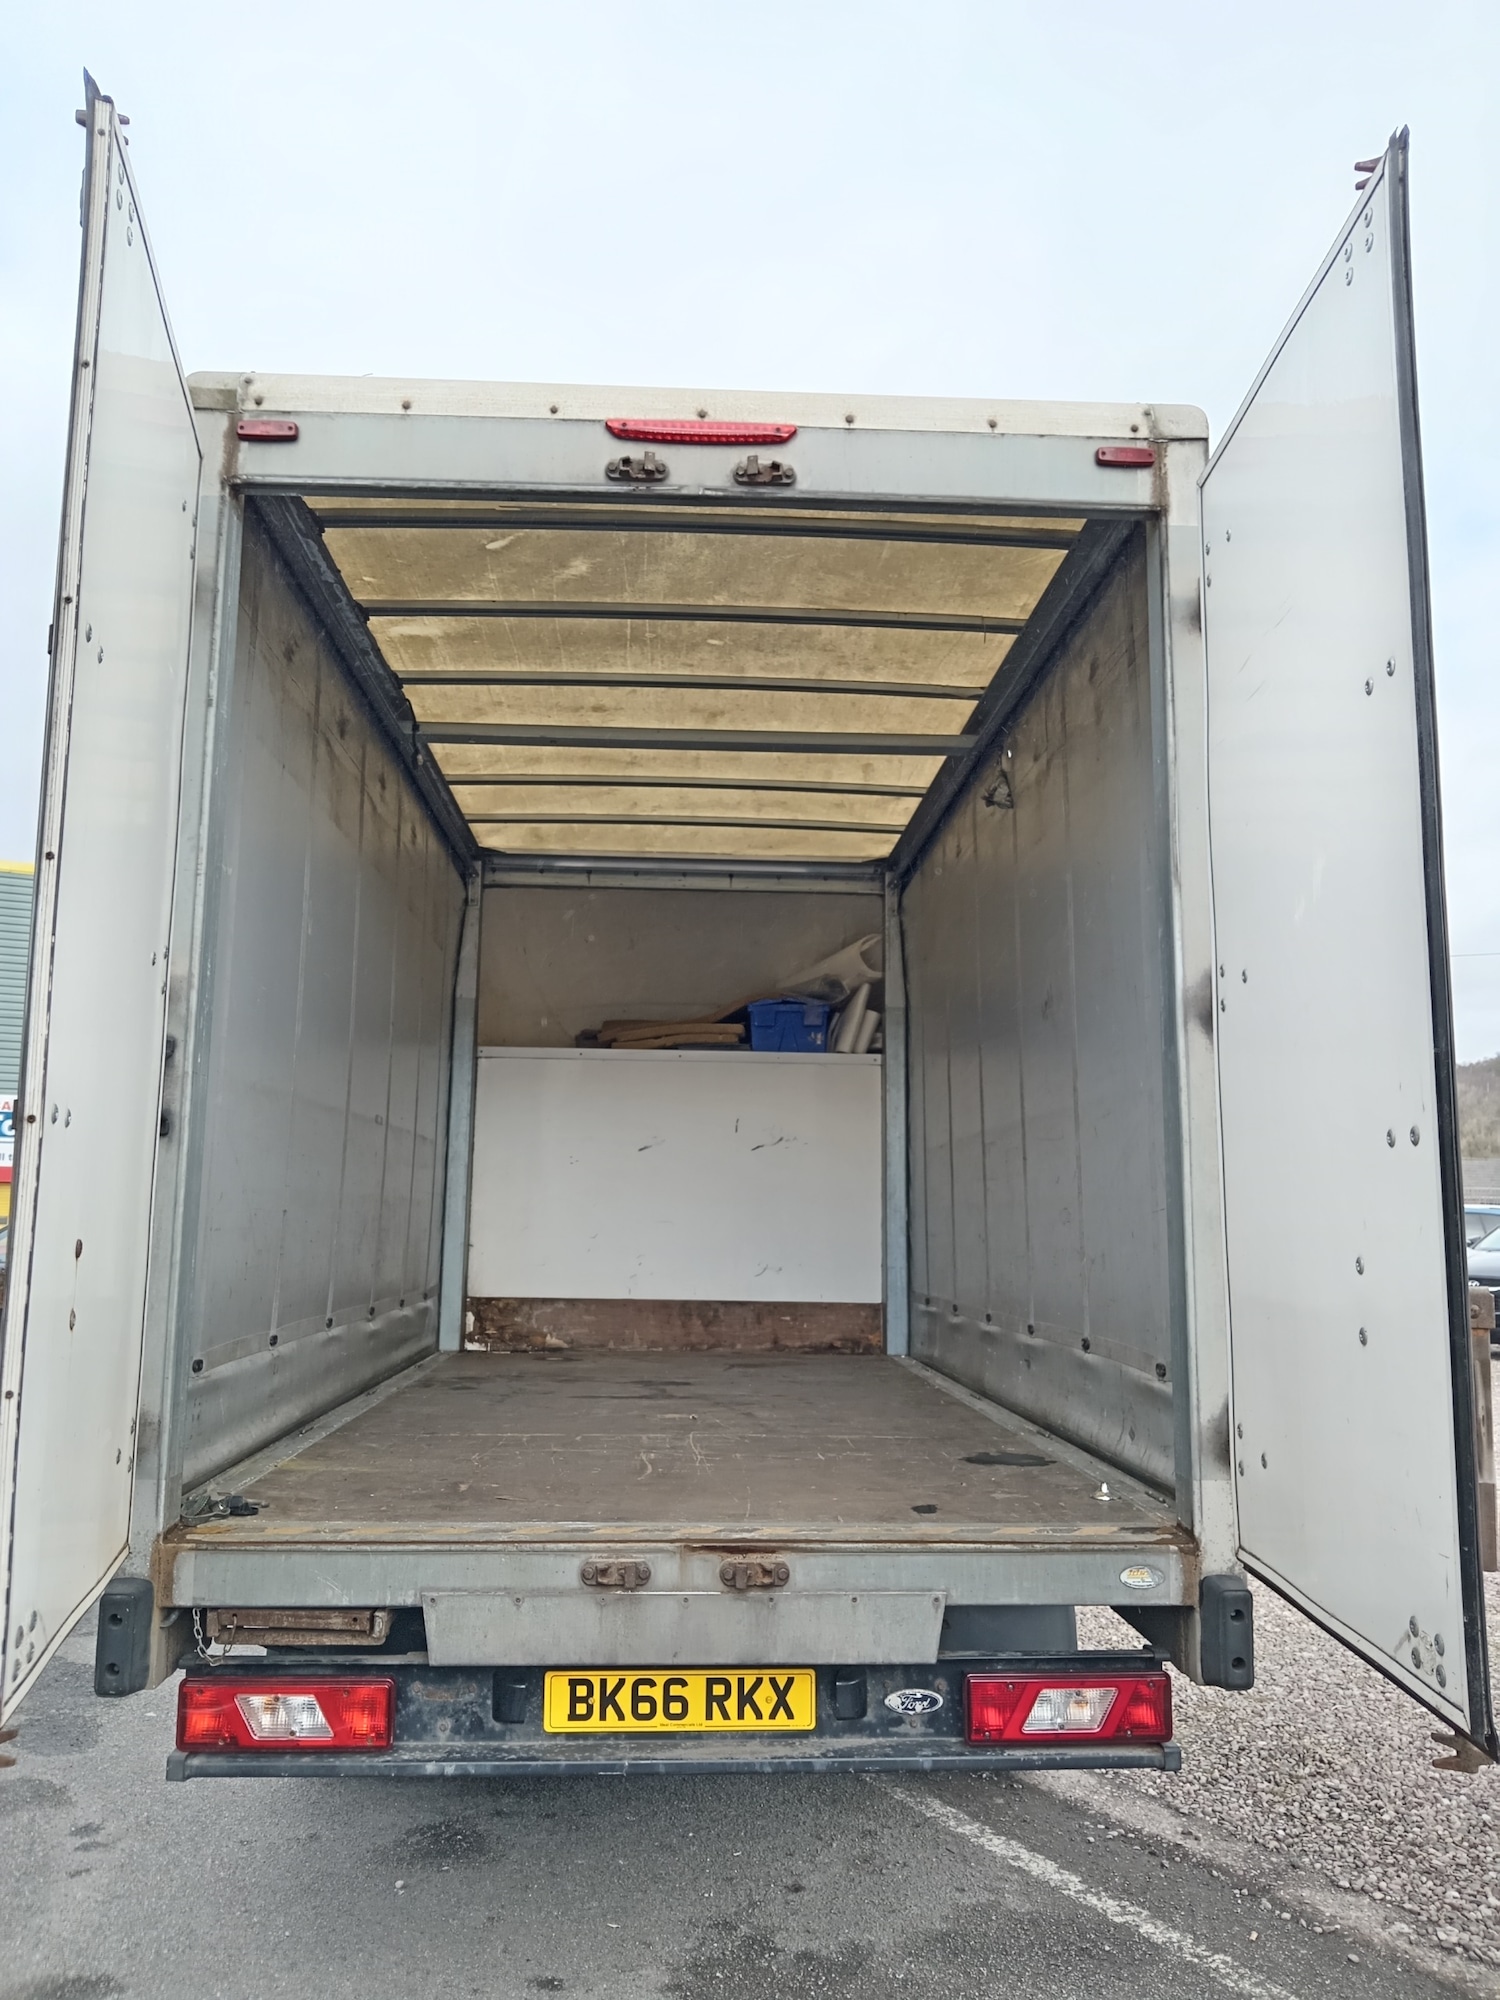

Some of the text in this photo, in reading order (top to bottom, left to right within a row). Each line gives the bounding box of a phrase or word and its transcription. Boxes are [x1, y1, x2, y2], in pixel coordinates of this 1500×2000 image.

[567, 1676, 795, 1722] BK66 RKX
[900, 1692, 931, 1710] Ford
